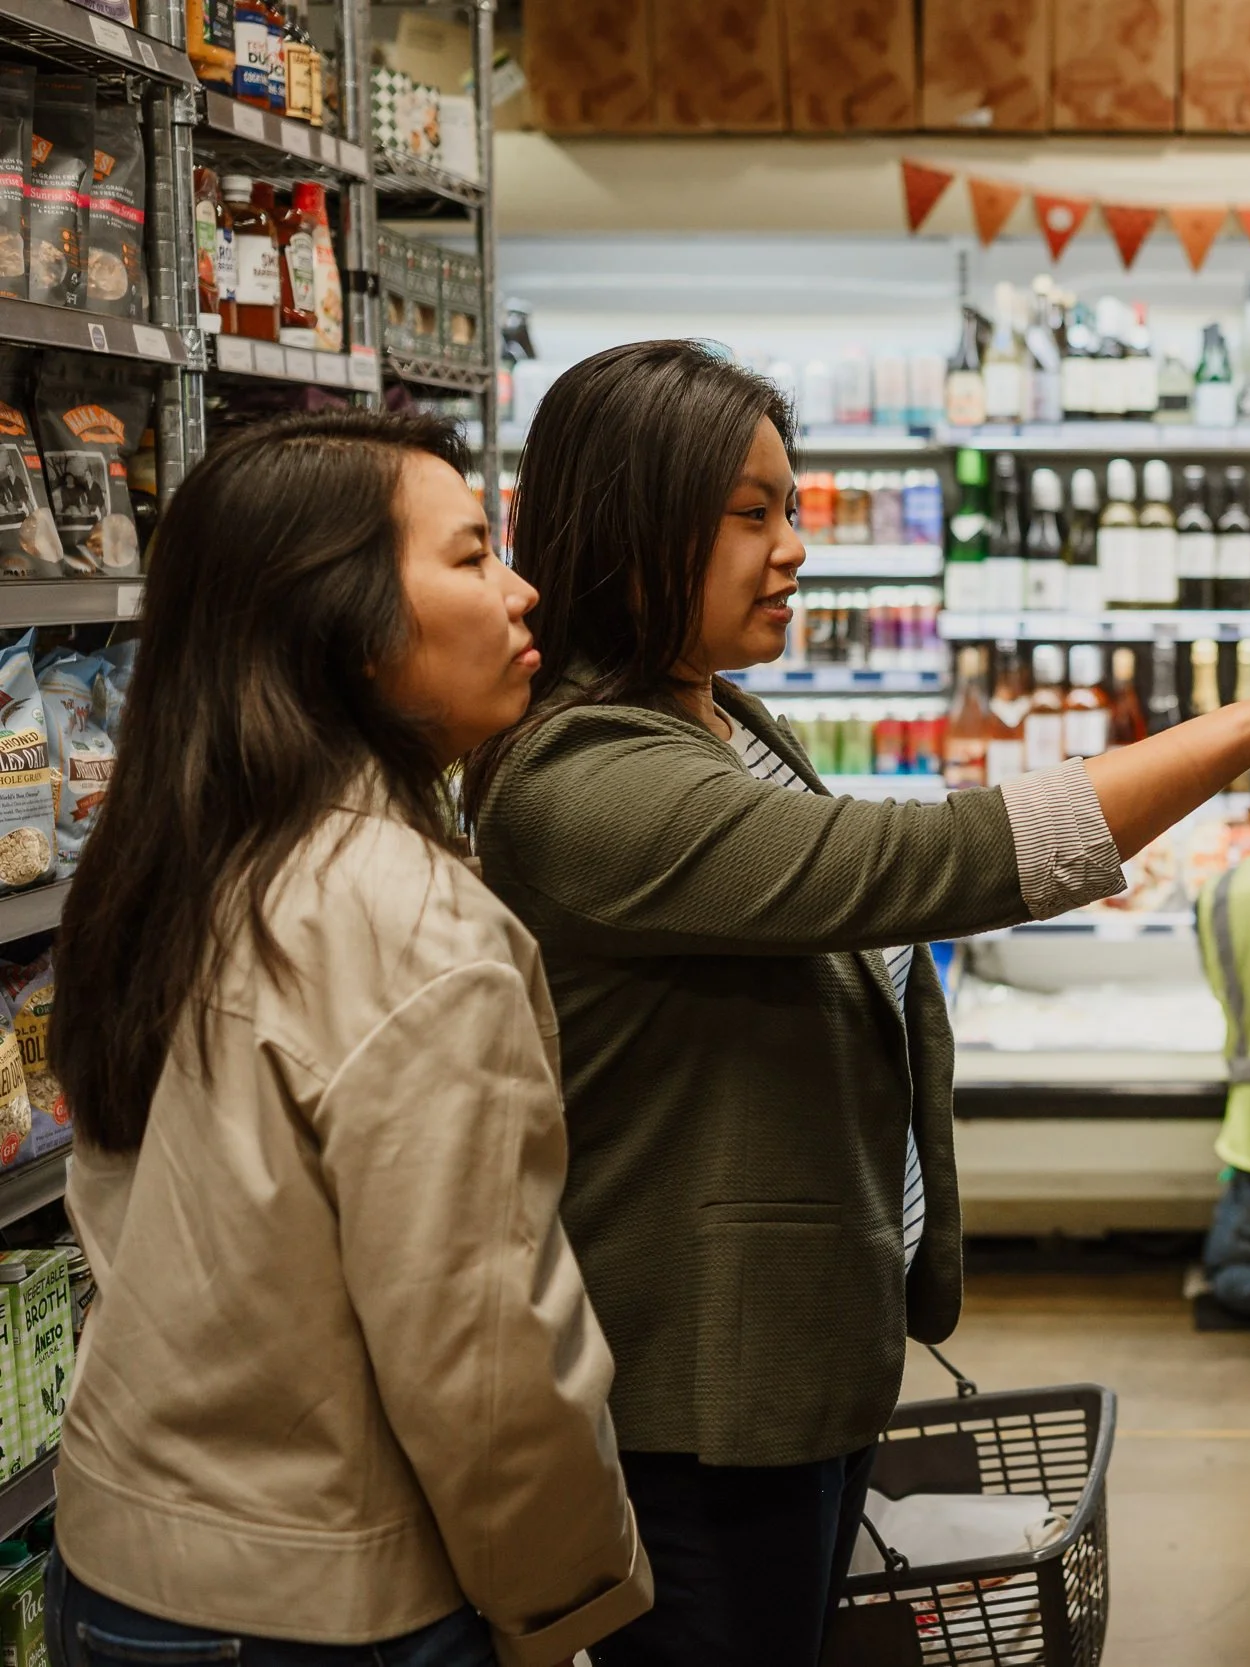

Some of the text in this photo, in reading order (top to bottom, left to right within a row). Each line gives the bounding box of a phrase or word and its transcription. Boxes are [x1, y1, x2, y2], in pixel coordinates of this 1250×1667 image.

[0, 731, 39, 751] SHIONED
[0, 752, 24, 772] LED
[0, 775, 23, 786] HOLE
[17, 1035, 48, 1066] ROL
[4, 1142, 17, 1157] GF
[23, 1264, 65, 1305] VEGETABLE
[25, 1283, 67, 1333] BROTH
[12, 1589, 45, 1631] Pac
